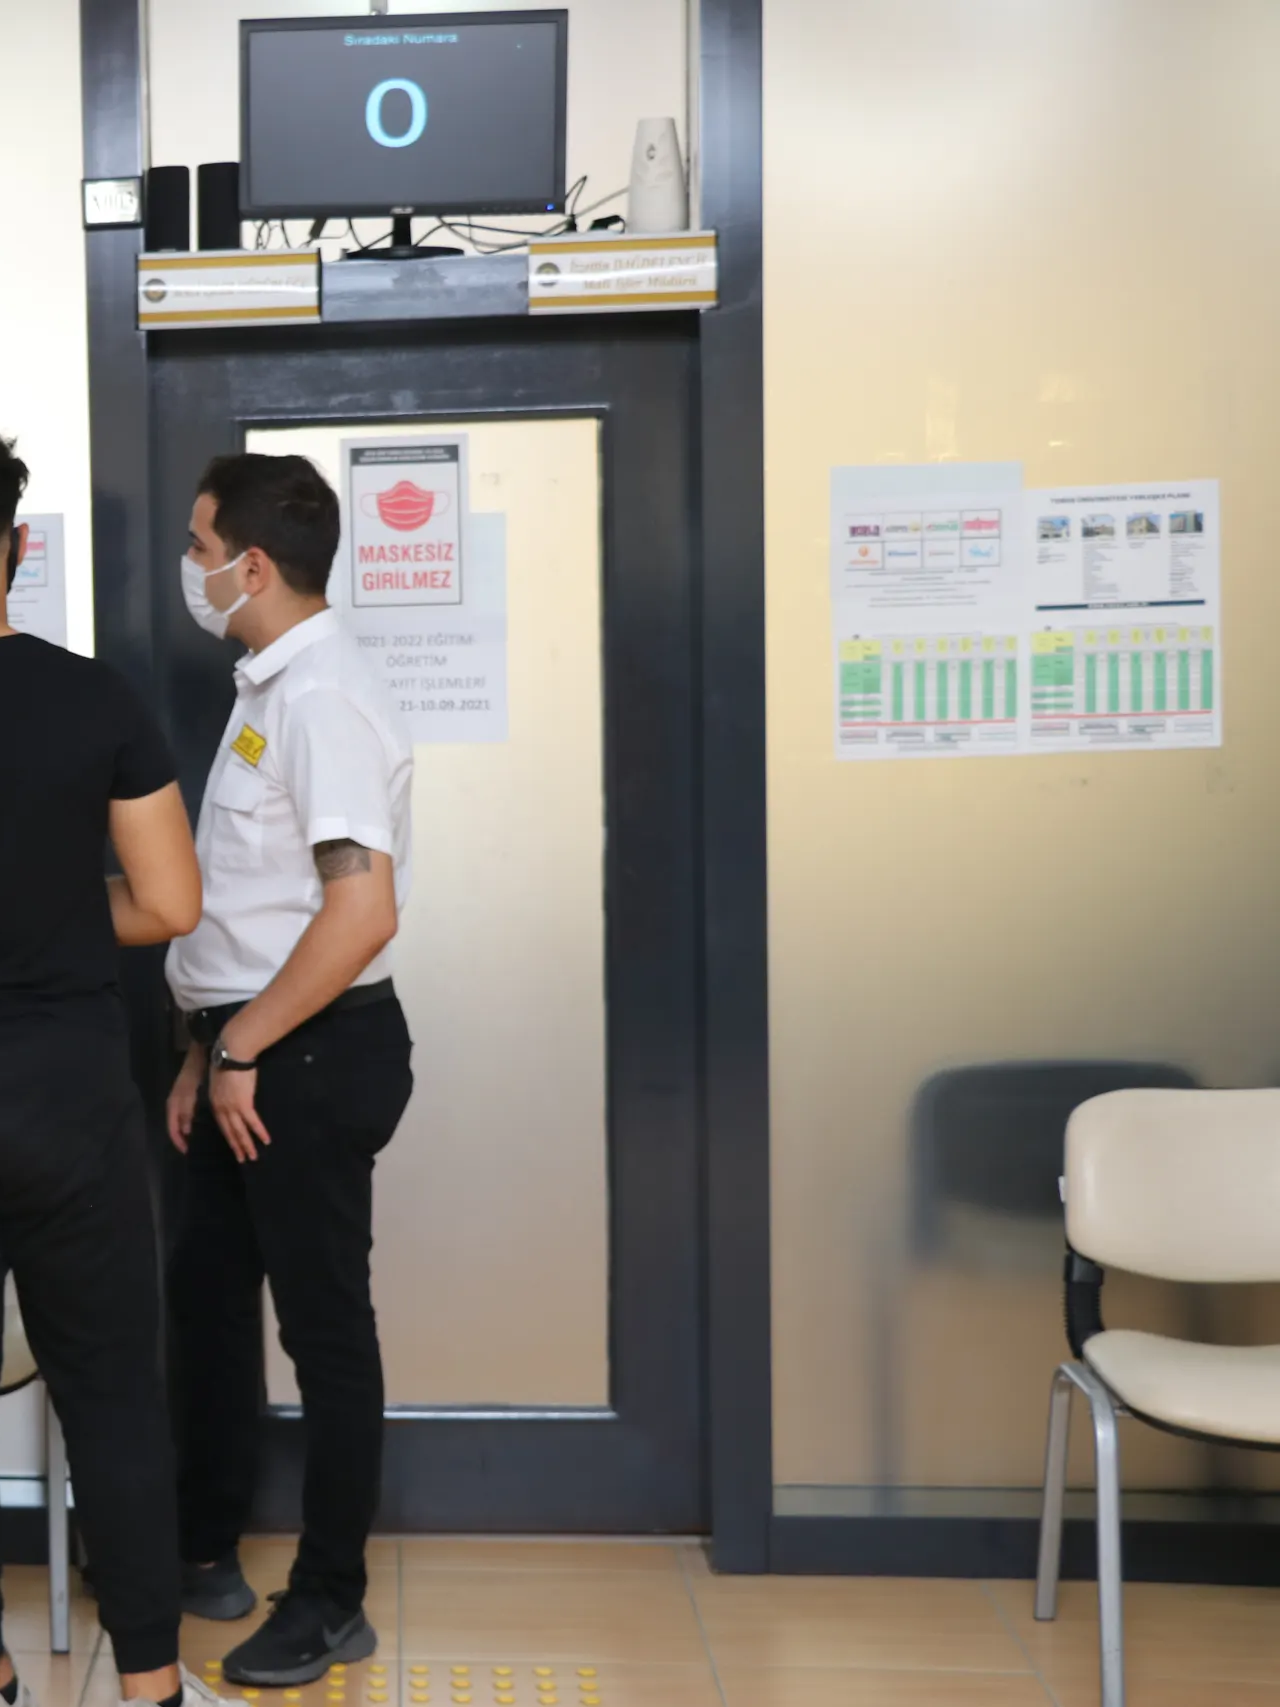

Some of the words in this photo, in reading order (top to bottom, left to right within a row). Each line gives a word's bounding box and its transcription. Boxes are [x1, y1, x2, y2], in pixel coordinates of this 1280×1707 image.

[403, 33, 458, 44] Numara
[358, 540, 454, 563] MASKESİZ
[362, 569, 452, 591] GİRİLMEZ
[382, 677, 417, 690] AYIT
